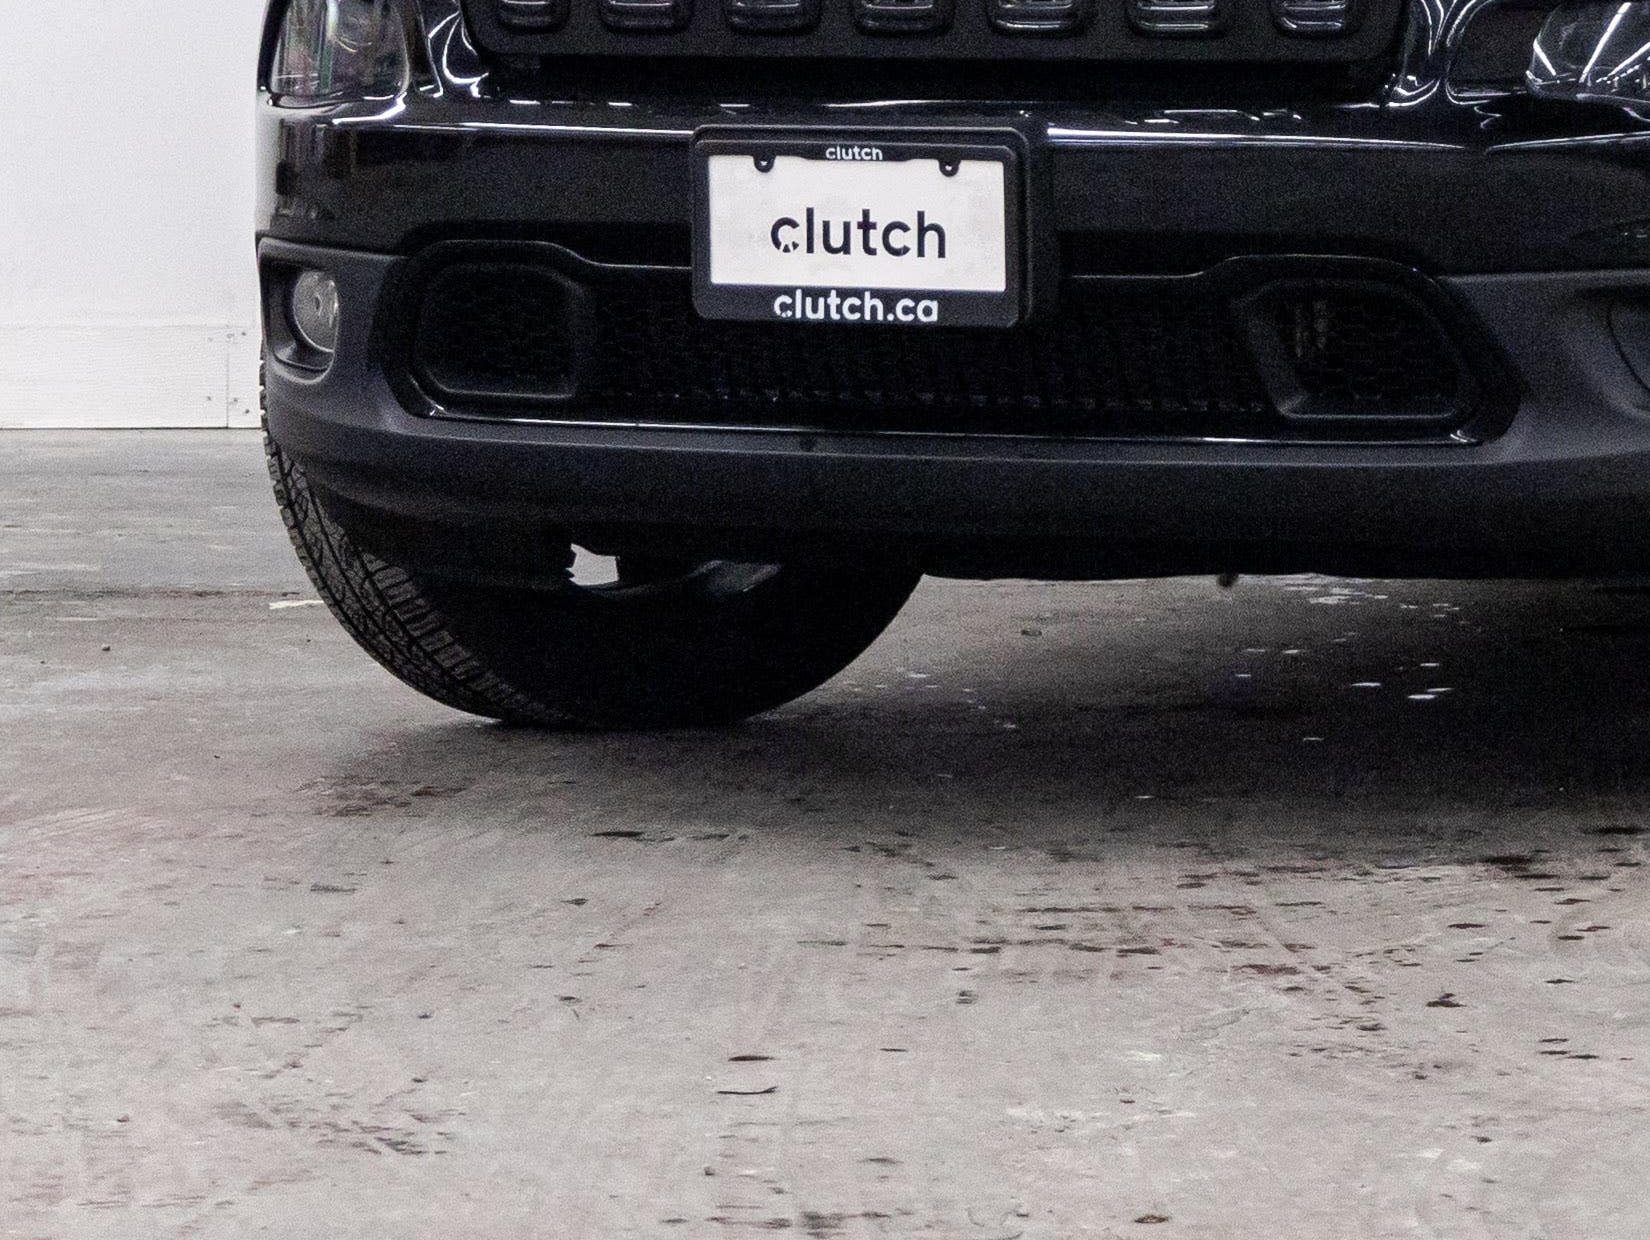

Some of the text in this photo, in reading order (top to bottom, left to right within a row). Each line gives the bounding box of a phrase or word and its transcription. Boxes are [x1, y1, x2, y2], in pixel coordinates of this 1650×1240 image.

[825, 145, 883, 161] clutch
[770, 207, 946, 259] clutch
[773, 289, 939, 323] clutch.ca
